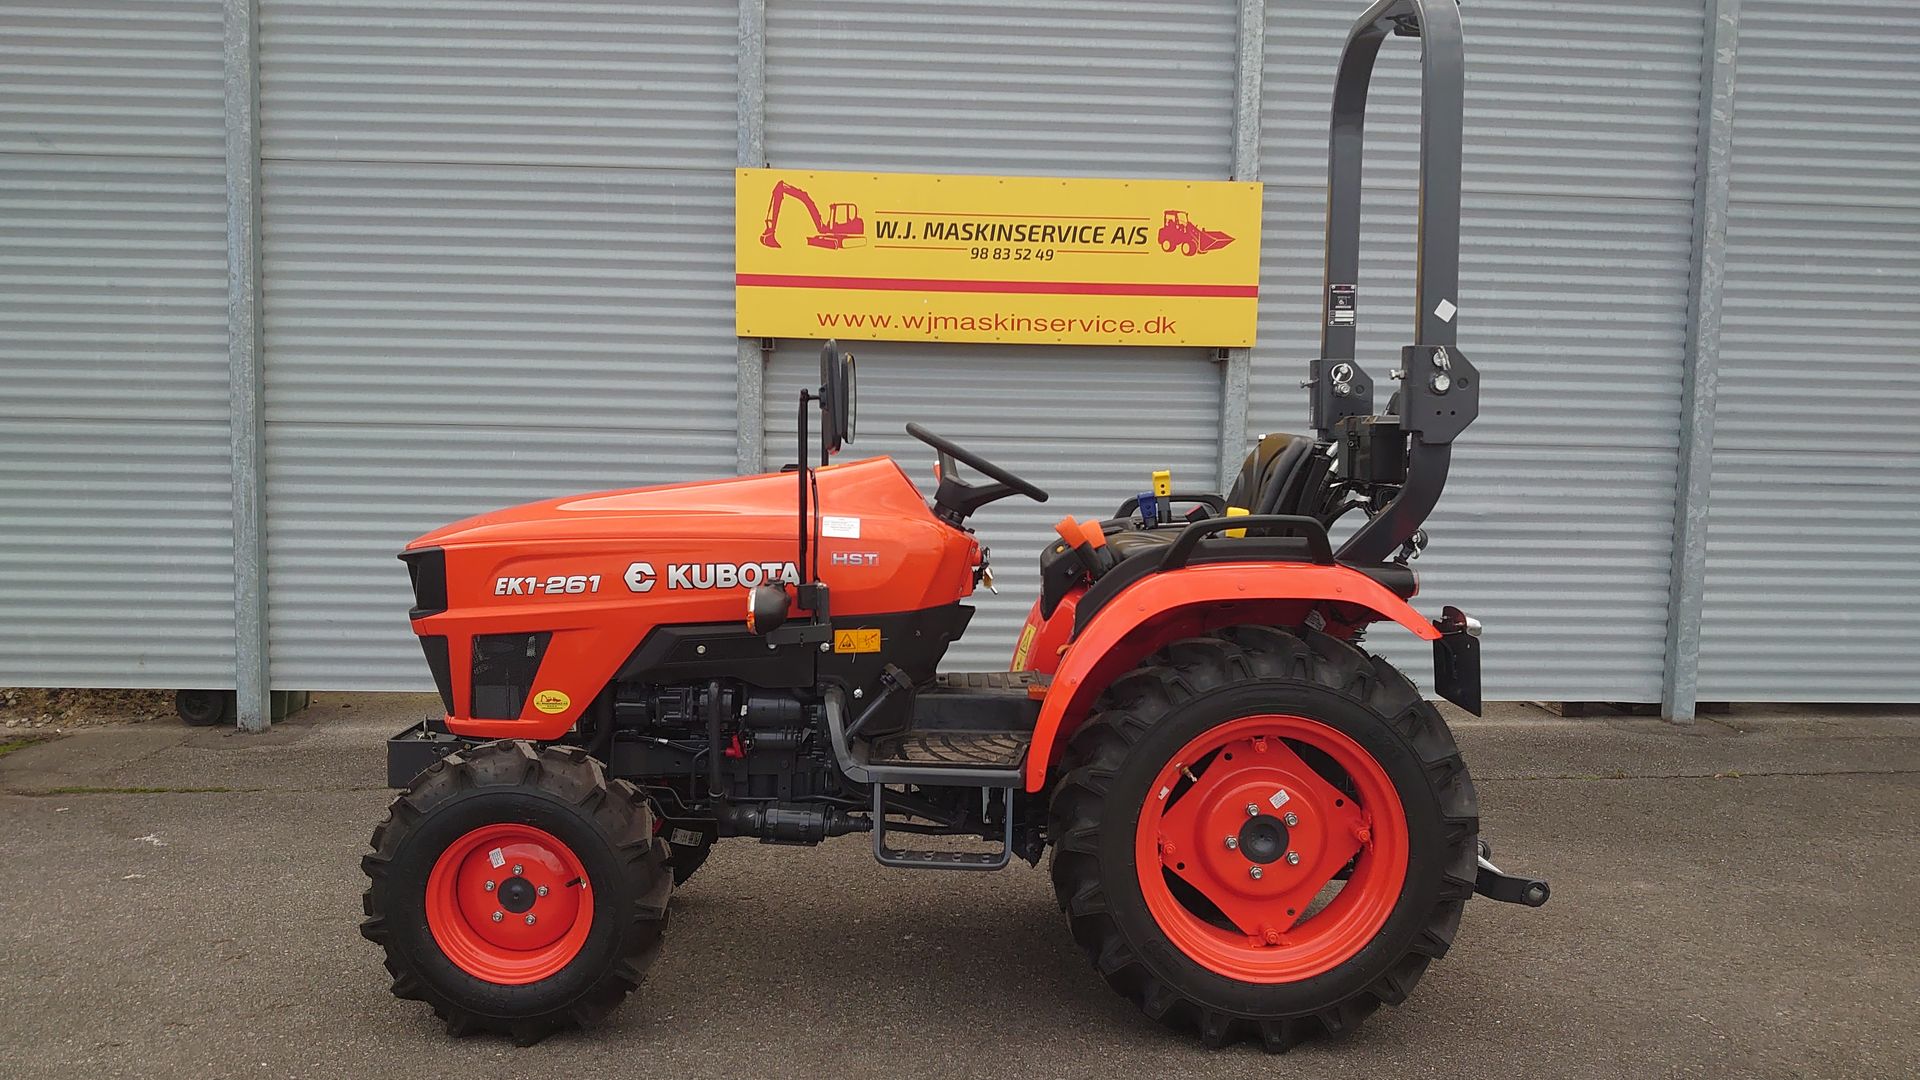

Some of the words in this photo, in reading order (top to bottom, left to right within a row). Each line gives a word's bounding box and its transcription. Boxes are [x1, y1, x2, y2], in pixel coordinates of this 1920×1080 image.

[876, 220, 916, 240] W.J.
[923, 222, 1106, 244] MASKINSERVICE
[1110, 226, 1149, 245] A/S
[970, 247, 989, 260] 98
[992, 248, 1011, 261] 83
[1013, 248, 1032, 261] 52
[1035, 249, 1054, 262] 49
[816, 311, 1177, 335] www.wjmaskinservice.dk
[831, 552, 879, 566] HST
[494, 575, 601, 595] EK1-261
[667, 562, 801, 590] KUBOTA
